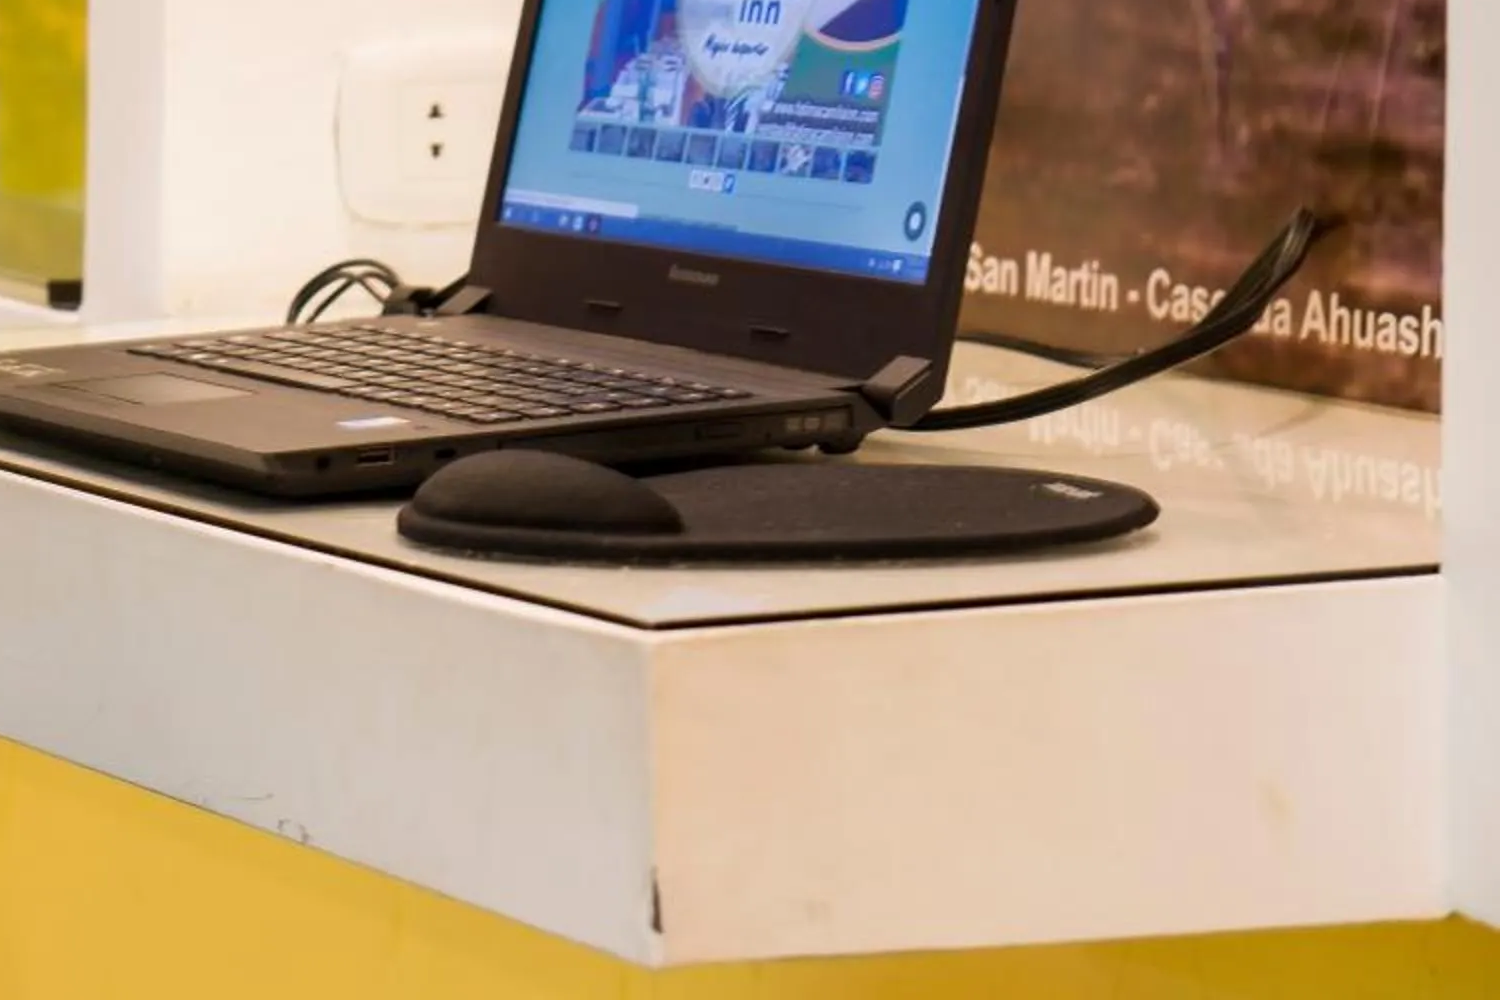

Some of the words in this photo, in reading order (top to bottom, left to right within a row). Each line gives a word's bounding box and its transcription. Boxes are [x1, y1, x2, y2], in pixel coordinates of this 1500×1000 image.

[964, 241, 1019, 296] San
[1025, 249, 1119, 312] Martin
[1300, 288, 1443, 359] Ahuash
